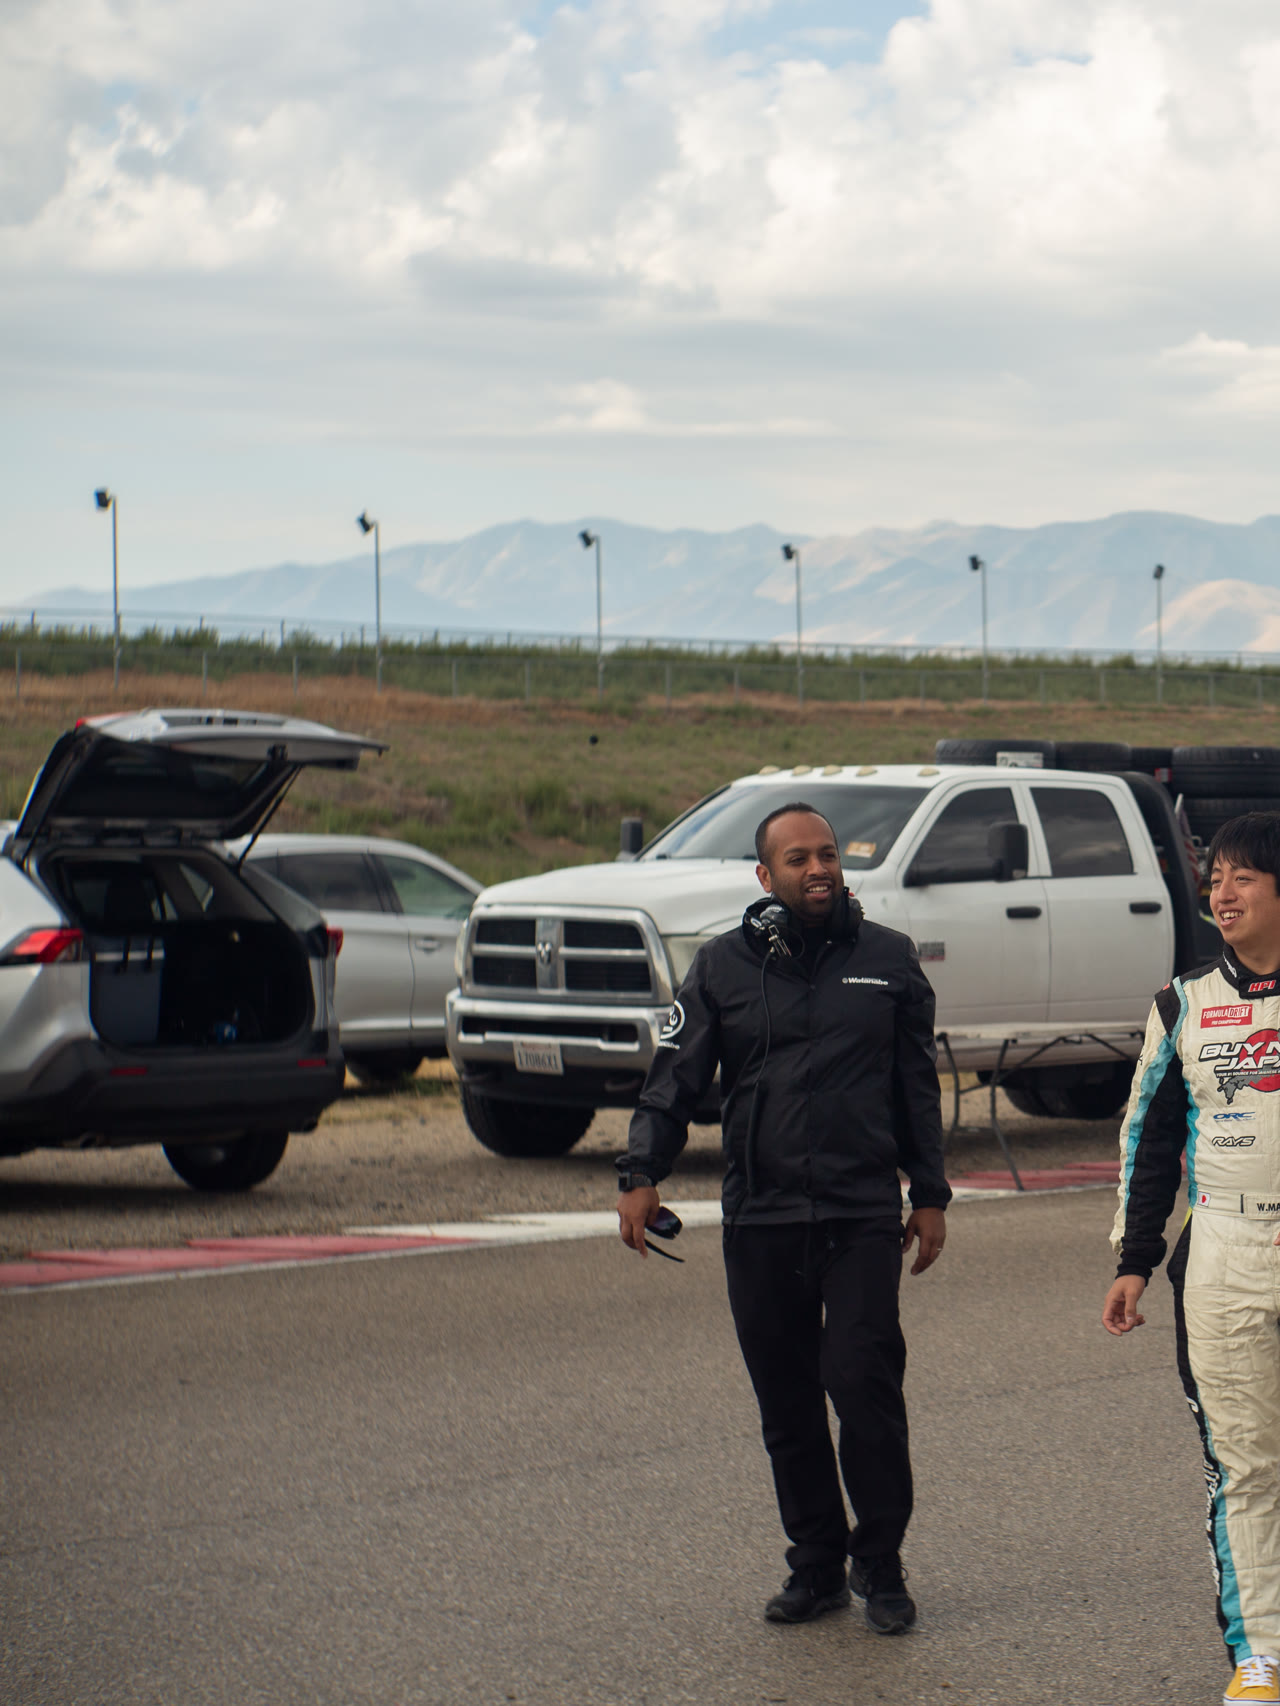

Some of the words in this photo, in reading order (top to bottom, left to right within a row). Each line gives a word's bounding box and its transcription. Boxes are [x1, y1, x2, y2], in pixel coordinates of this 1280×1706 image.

[848, 977, 889, 985] Watanabe
[1248, 980, 1276, 992] HPI
[1203, 1009, 1228, 1019] FORMULA
[1228, 1006, 1249, 1017] DRIFT
[1199, 1041, 1266, 1061] BUY
[1213, 1112, 1256, 1120] ORC
[1212, 1136, 1256, 1147] RAYS
